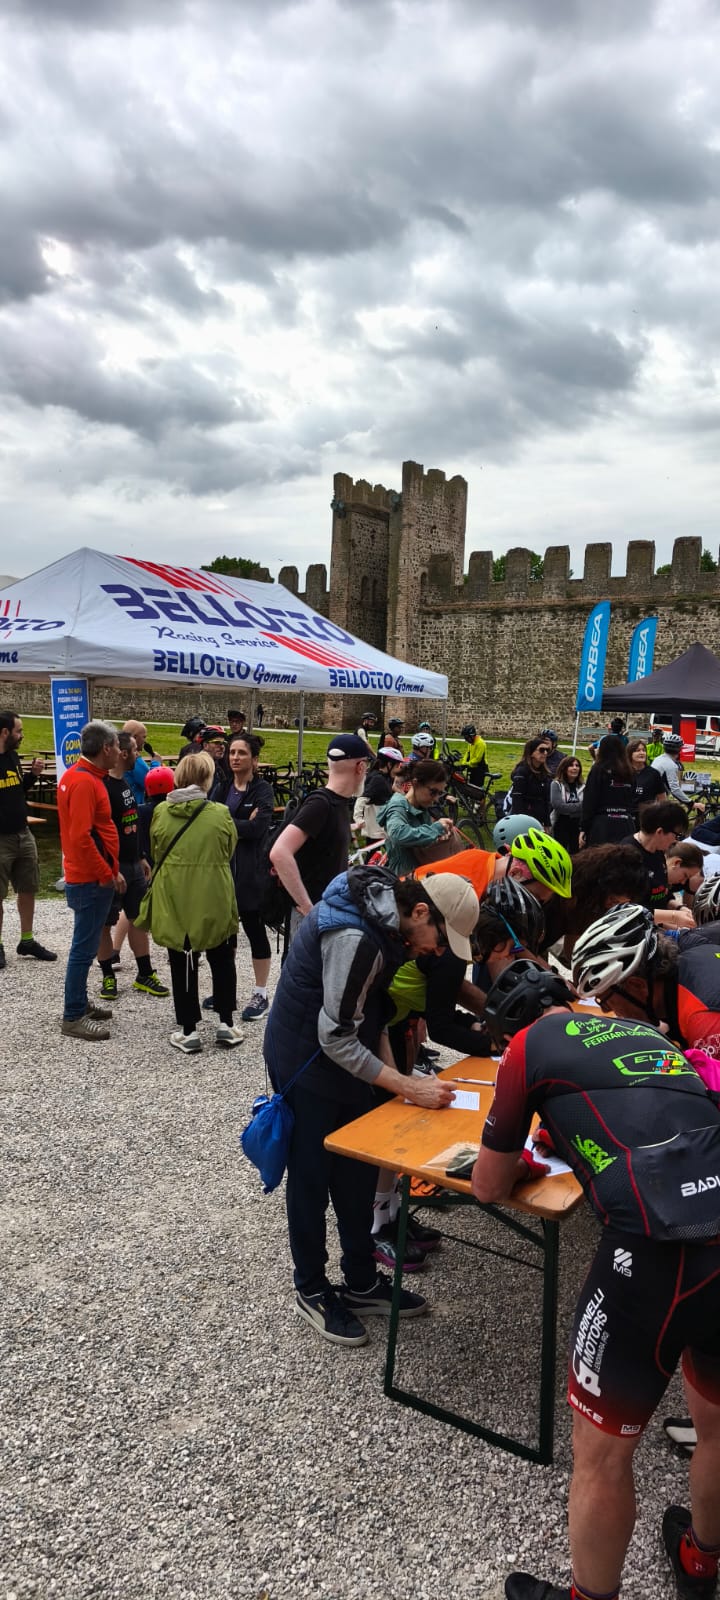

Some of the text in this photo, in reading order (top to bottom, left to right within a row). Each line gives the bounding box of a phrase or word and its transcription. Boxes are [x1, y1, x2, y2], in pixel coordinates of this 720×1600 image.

[100, 584, 355, 646] BELLOTTO
[151, 625, 279, 649] Racing Service
[152, 649, 298, 685] BELLOTTO Gomme
[585, 613, 603, 702] ORBEA
[329, 668, 425, 693] BELLOTTO Gomme
[584, 1031, 628, 1048] FERRARI
[575, 1287, 605, 1356] MARINELLI
[582, 1309, 608, 1368] MOTORS
[570, 1393, 604, 1425] BIKE
